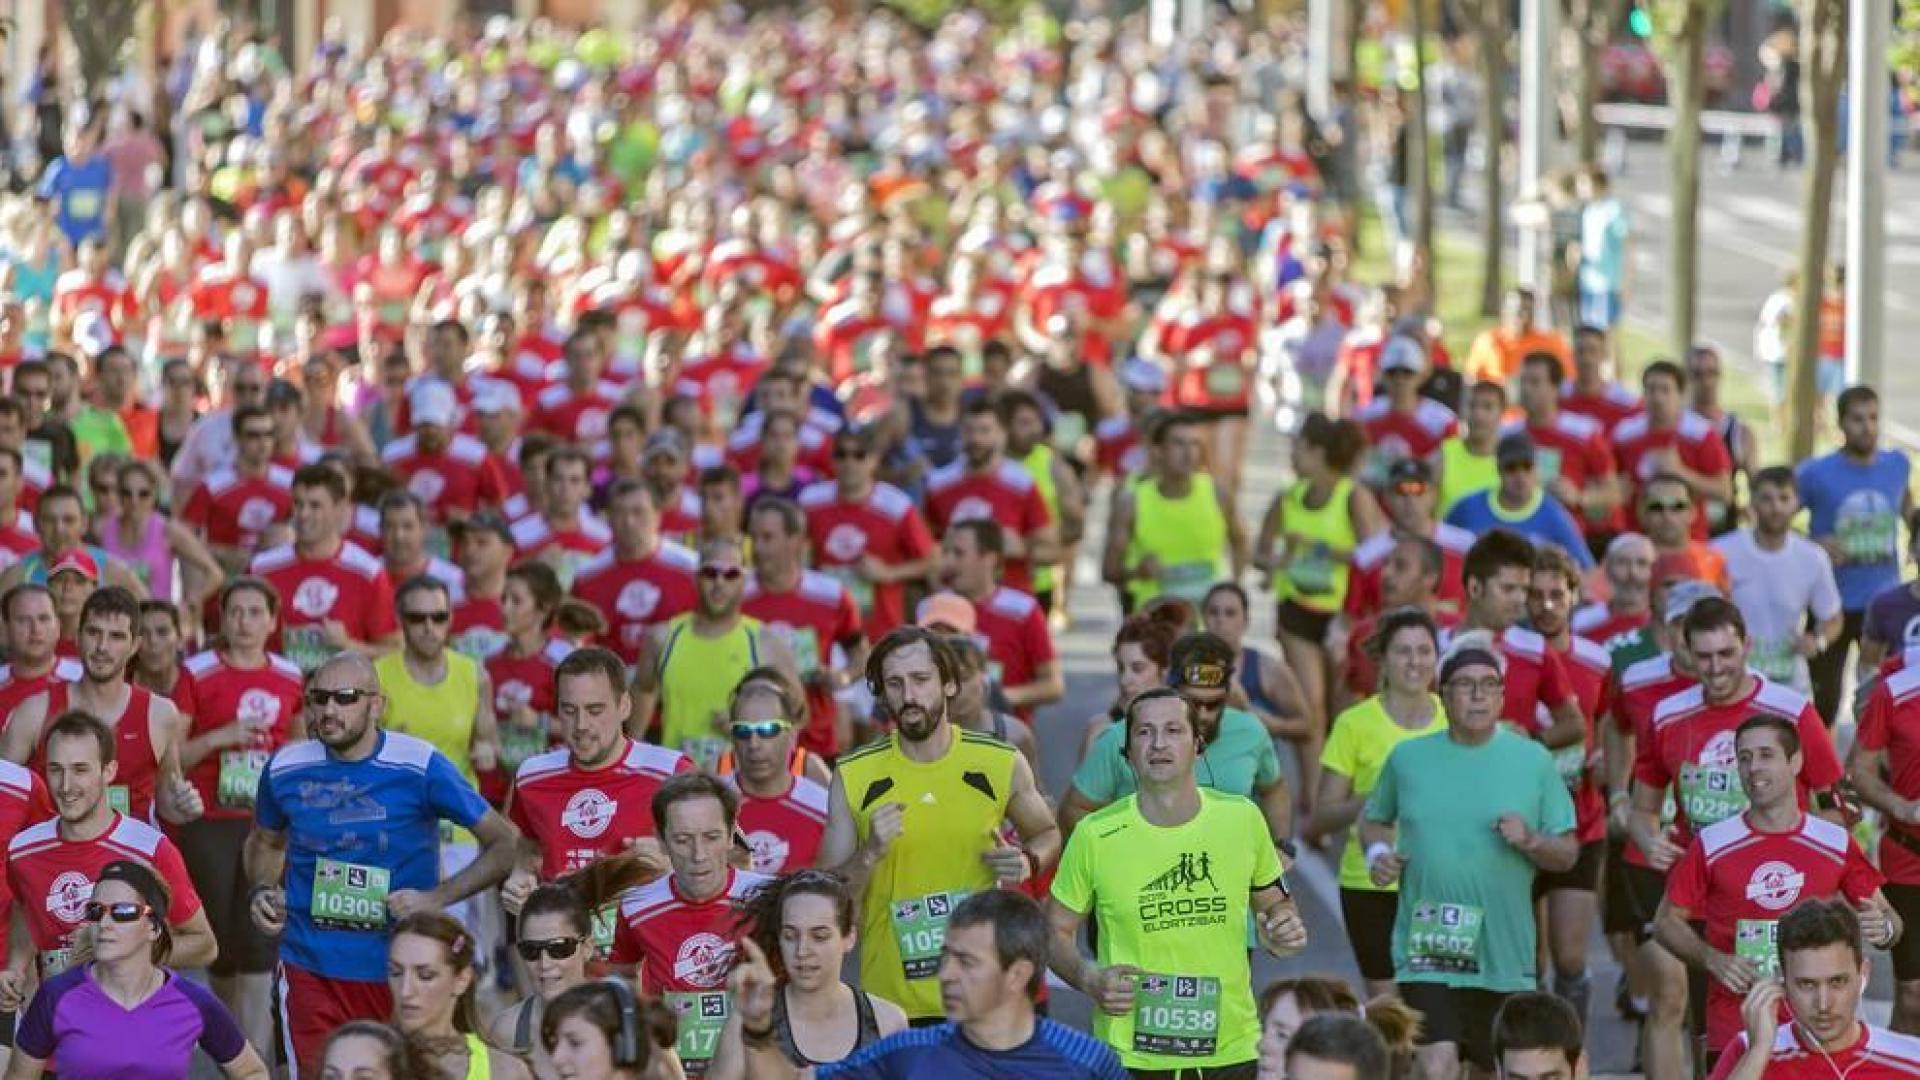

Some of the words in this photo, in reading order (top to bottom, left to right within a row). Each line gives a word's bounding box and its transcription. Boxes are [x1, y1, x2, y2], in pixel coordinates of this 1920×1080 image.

[317, 892, 384, 918] 10305
[1139, 896, 1227, 920] CROSS
[901, 927, 946, 953] 105
[1409, 932, 1475, 955] 11502
[1140, 1006, 1217, 1032] 10538
[686, 1027, 721, 1052] 17
